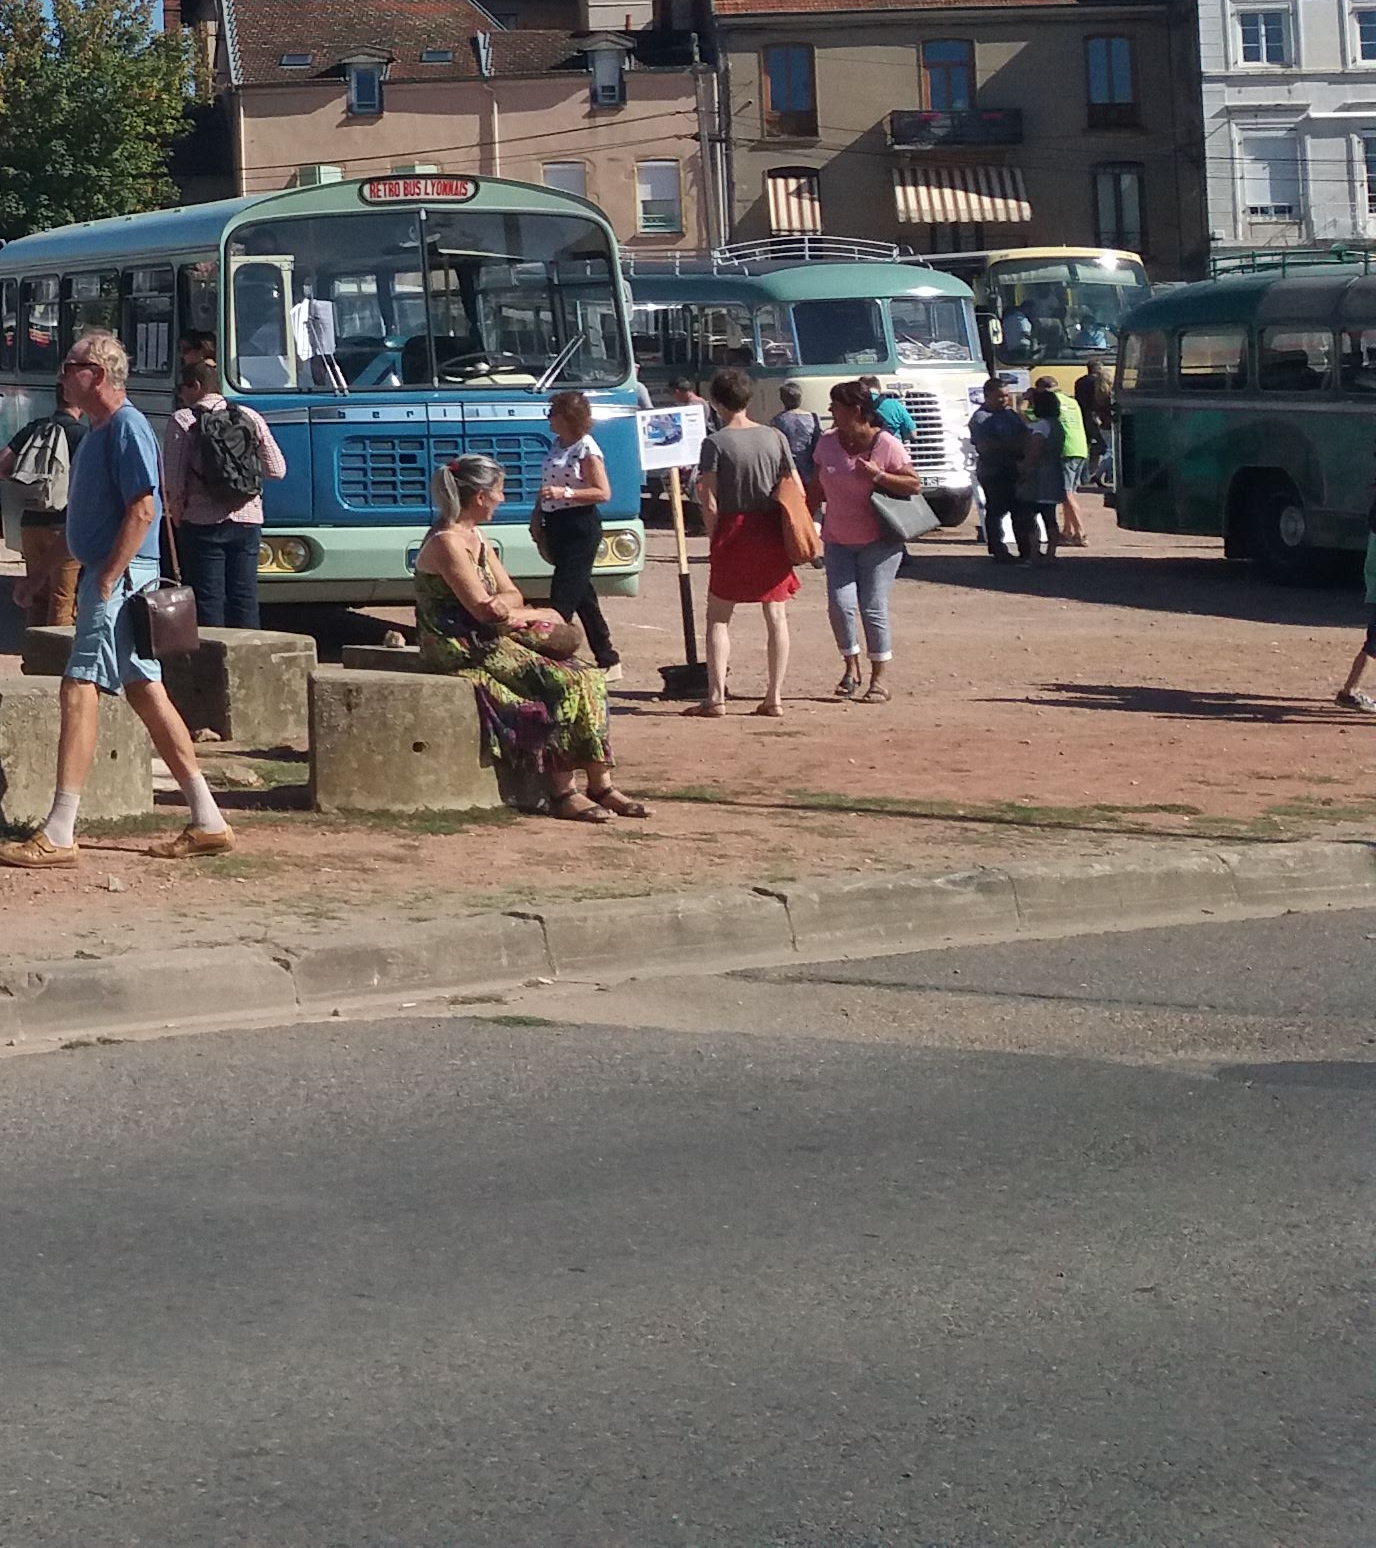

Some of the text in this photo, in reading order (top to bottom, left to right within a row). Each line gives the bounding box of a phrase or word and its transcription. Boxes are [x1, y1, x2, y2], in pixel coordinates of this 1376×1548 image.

[369, 179, 468, 199] RETRO BUS LYONNAIS
